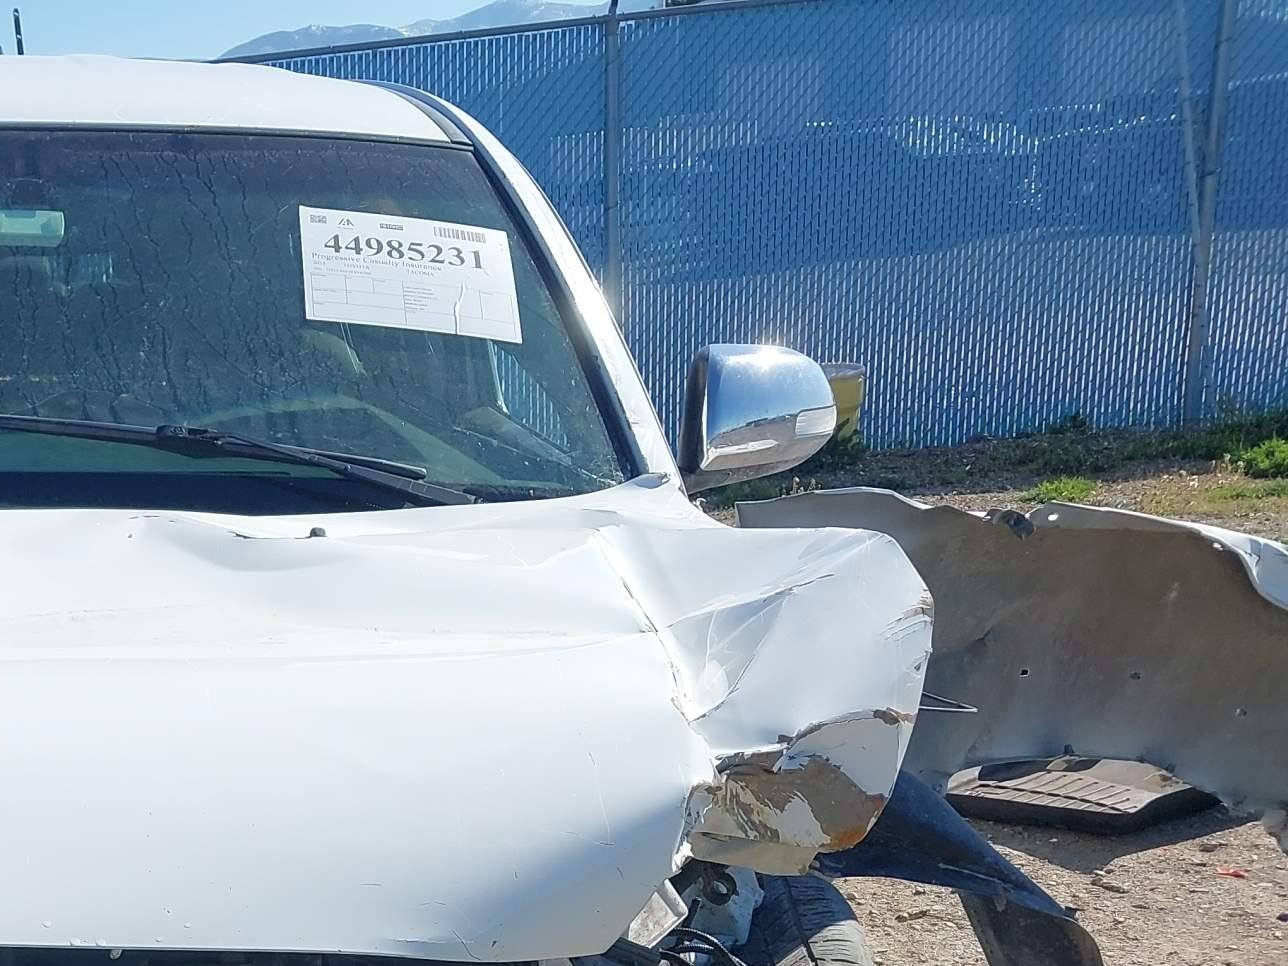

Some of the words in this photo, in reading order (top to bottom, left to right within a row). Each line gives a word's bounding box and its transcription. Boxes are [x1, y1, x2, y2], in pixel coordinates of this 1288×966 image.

[312, 252, 360, 263] Progressive
[363, 257, 399, 267] Casualty
[402, 261, 442, 271] Insurance
[324, 233, 483, 269] 44985231
